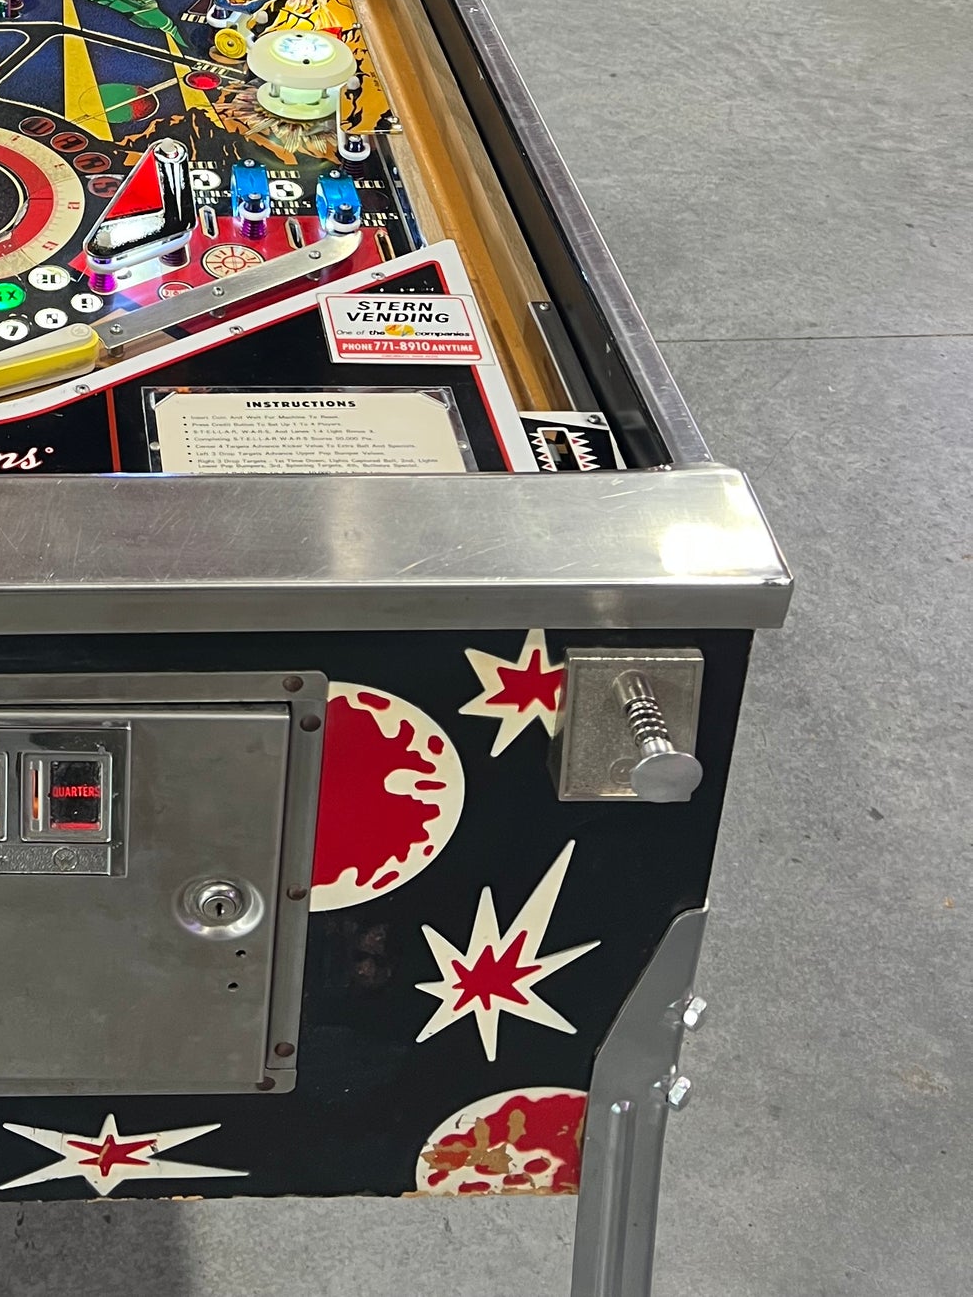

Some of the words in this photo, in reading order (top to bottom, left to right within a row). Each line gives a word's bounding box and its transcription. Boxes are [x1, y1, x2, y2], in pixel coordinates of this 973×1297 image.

[357, 301, 433, 312] STERN
[346, 312, 450, 323] VENDING
[342, 342, 373, 351] PHONE
[374, 340, 430, 352] 771-8910
[431, 344, 474, 352] ANYTIME
[246, 400, 356, 408] INSTRUCTIONS
